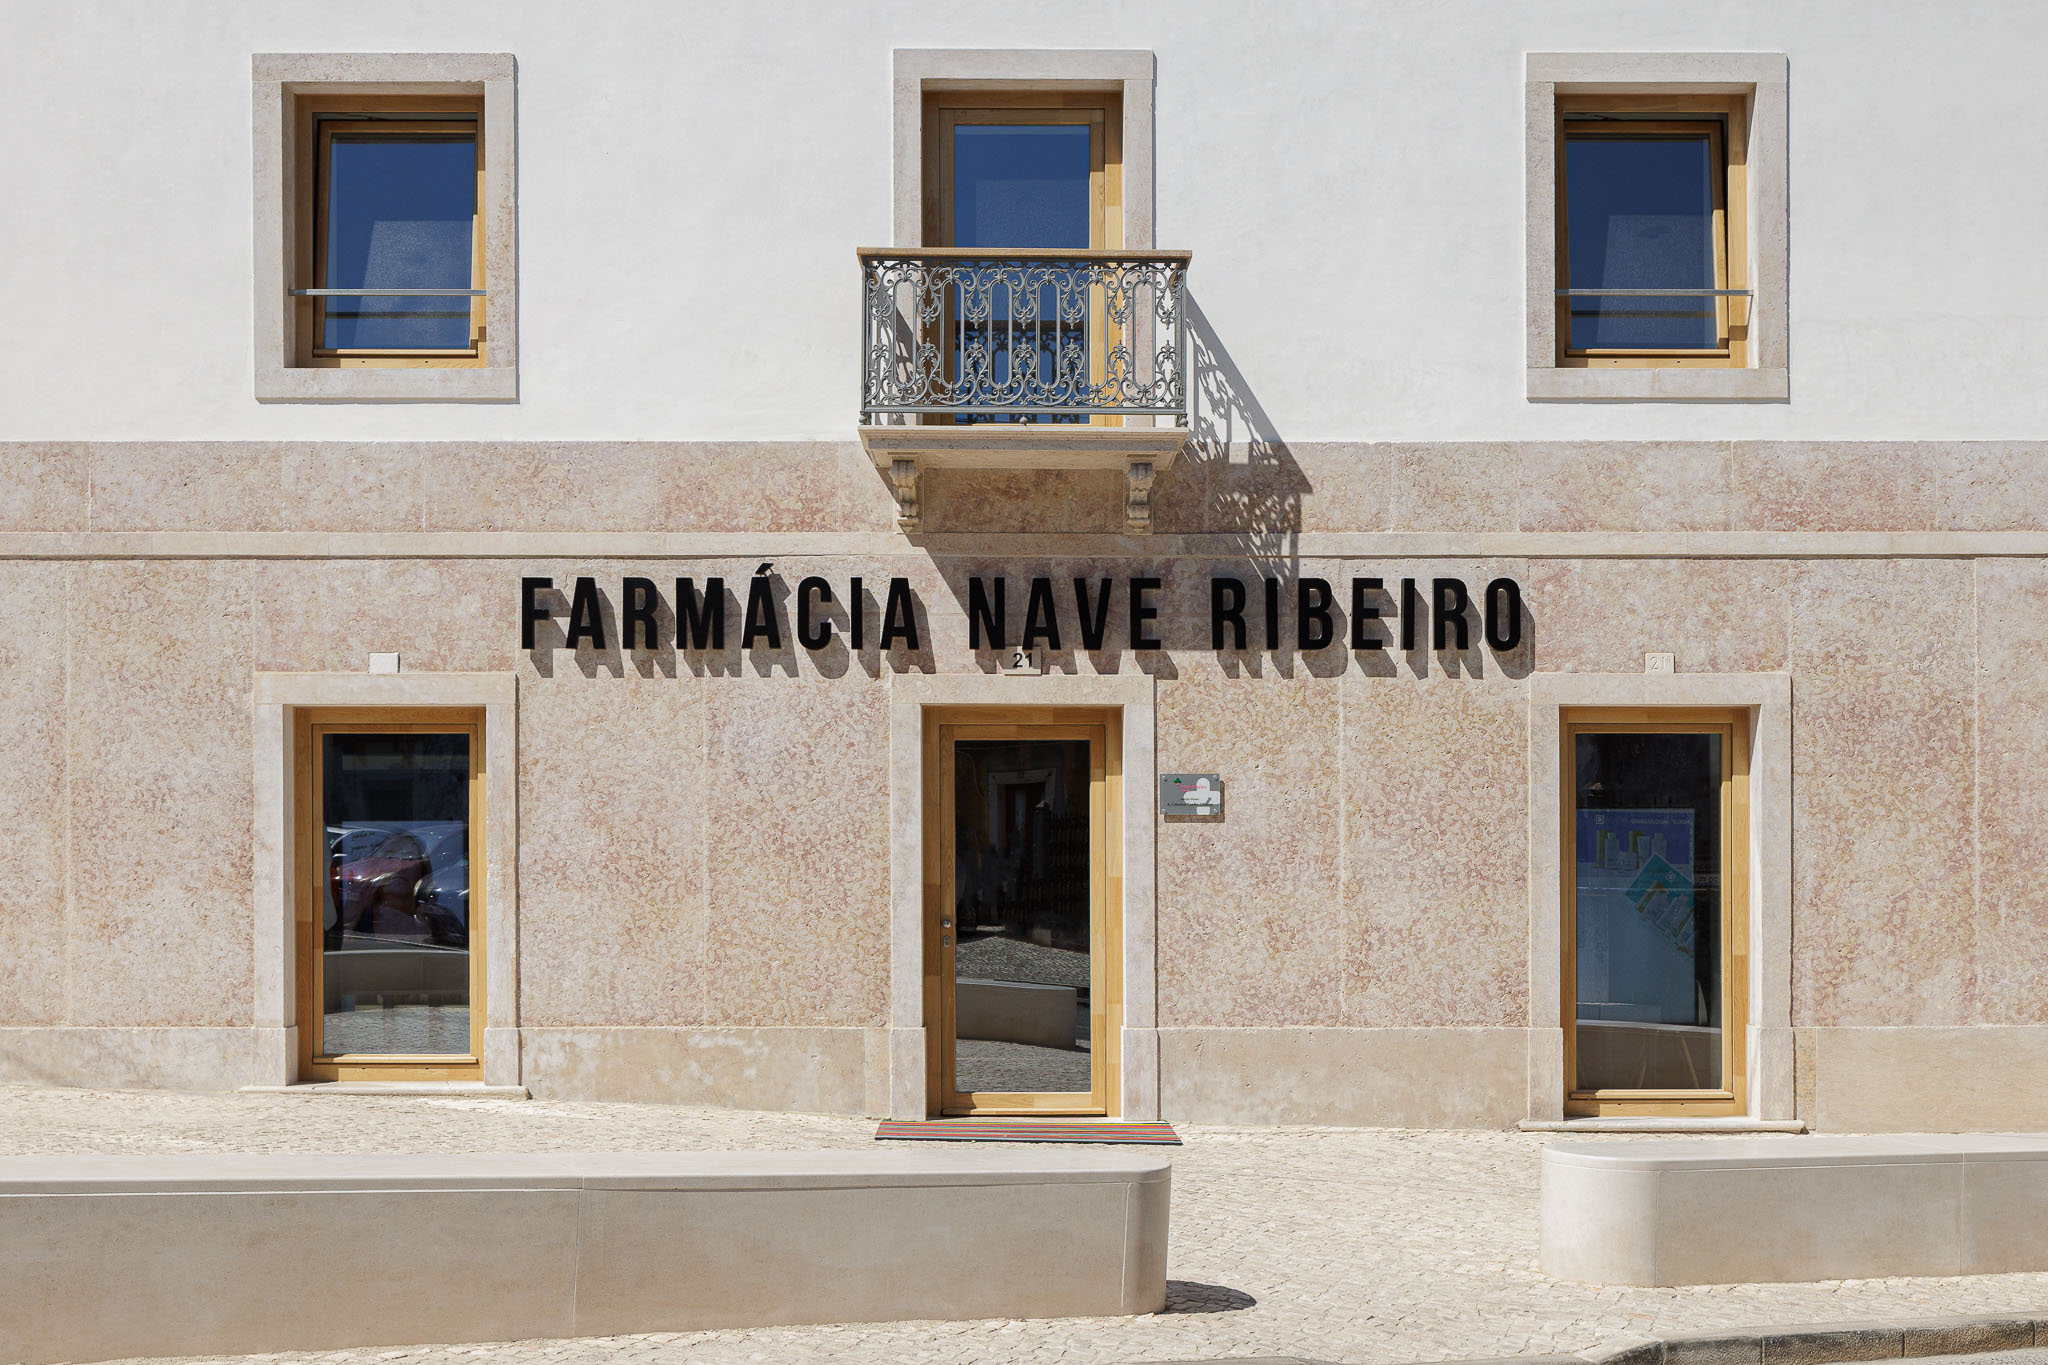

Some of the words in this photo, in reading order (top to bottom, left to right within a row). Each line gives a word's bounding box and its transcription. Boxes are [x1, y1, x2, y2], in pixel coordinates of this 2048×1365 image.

[521, 563, 920, 650] FARMÁCIA
[968, 577, 1162, 650] NAVE
[1211, 577, 1522, 651] RIBEIRO
[1012, 652, 1033, 668] 21
